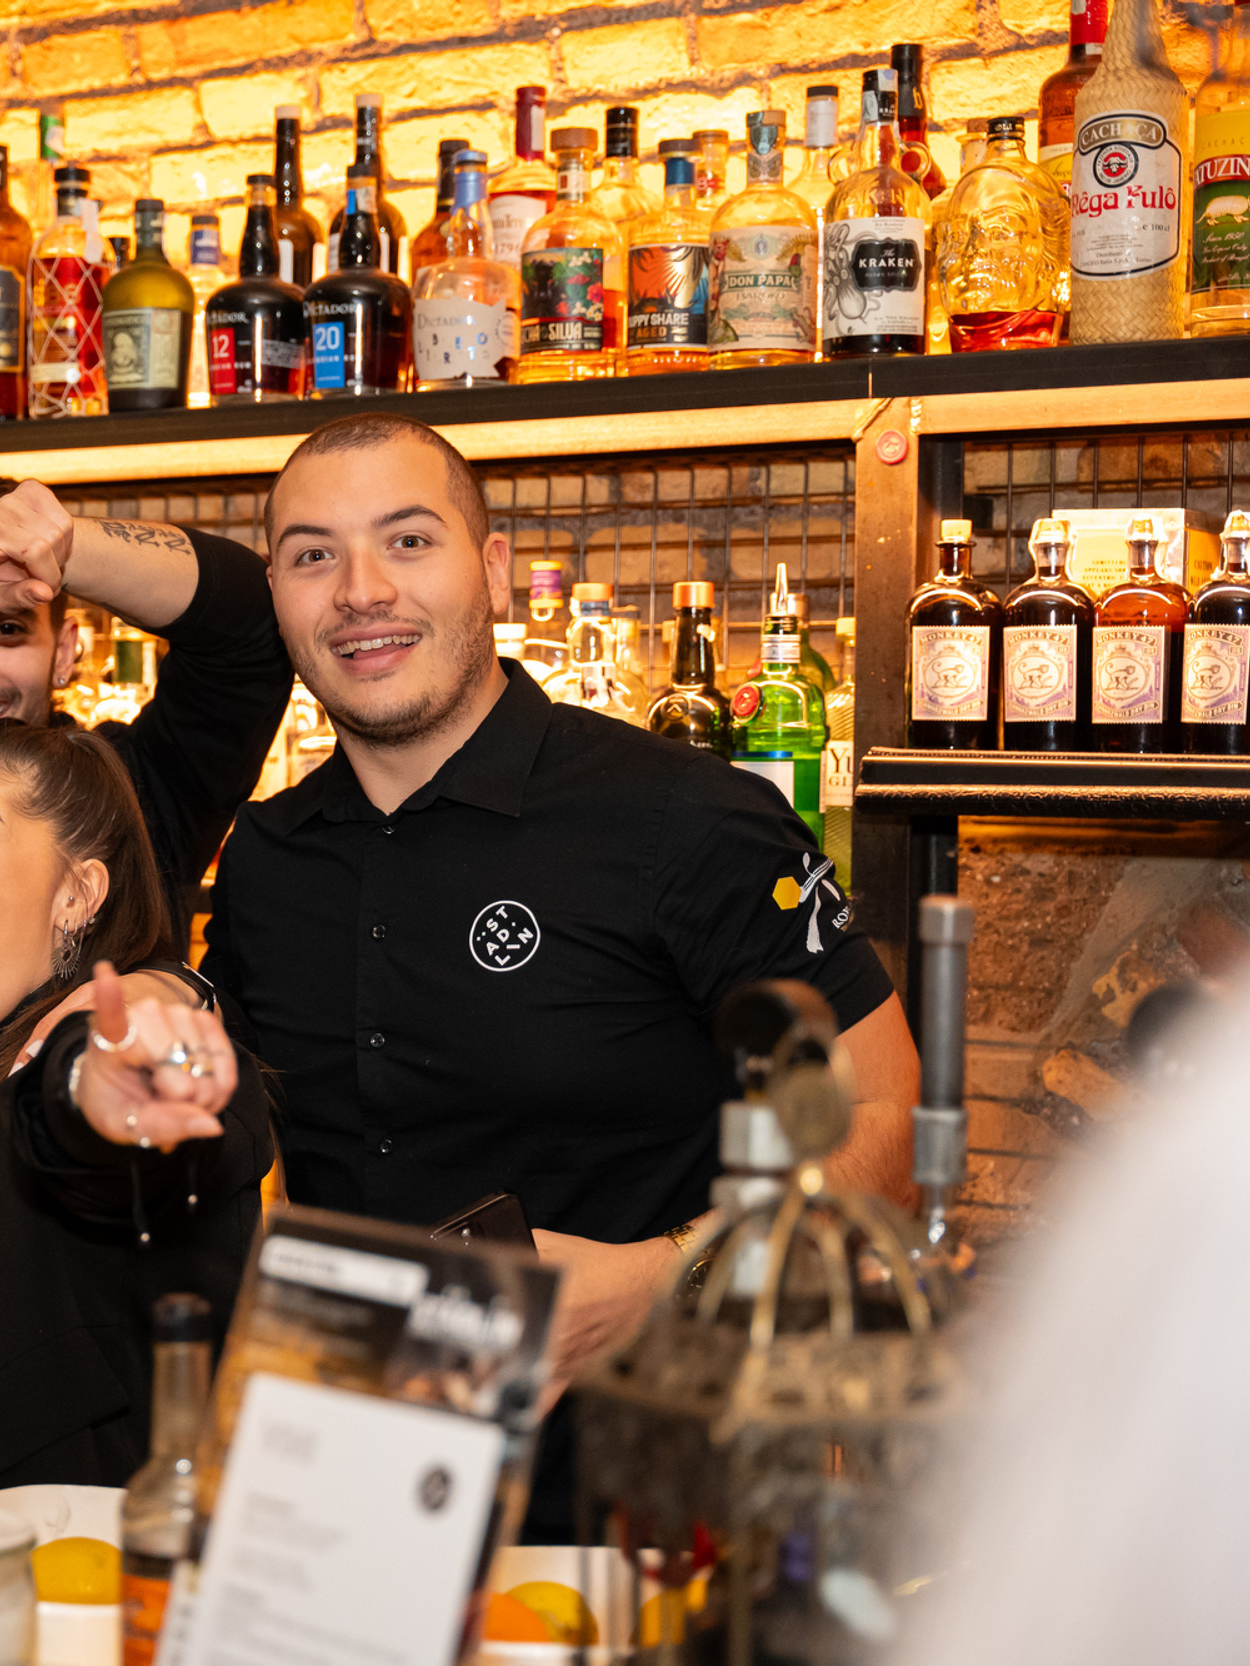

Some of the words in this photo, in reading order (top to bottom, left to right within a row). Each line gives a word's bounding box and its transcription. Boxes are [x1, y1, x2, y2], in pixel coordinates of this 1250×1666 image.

[1081, 121, 1158, 146] CACHAÇA
[1201, 136, 1250, 150] CACHAÇ
[859, 257, 914, 268] KRAKEN
[729, 275, 754, 288] DON
[757, 274, 790, 287] PAPA
[650, 312, 689, 327] SHARE
[314, 325, 341, 351] 20
[213, 333, 230, 359] 12
[919, 632, 966, 646] MONKEY
[1008, 631, 1051, 646] MONKEY
[1096, 631, 1138, 647] MONKEY
[1187, 630, 1223, 643] MONKEY
